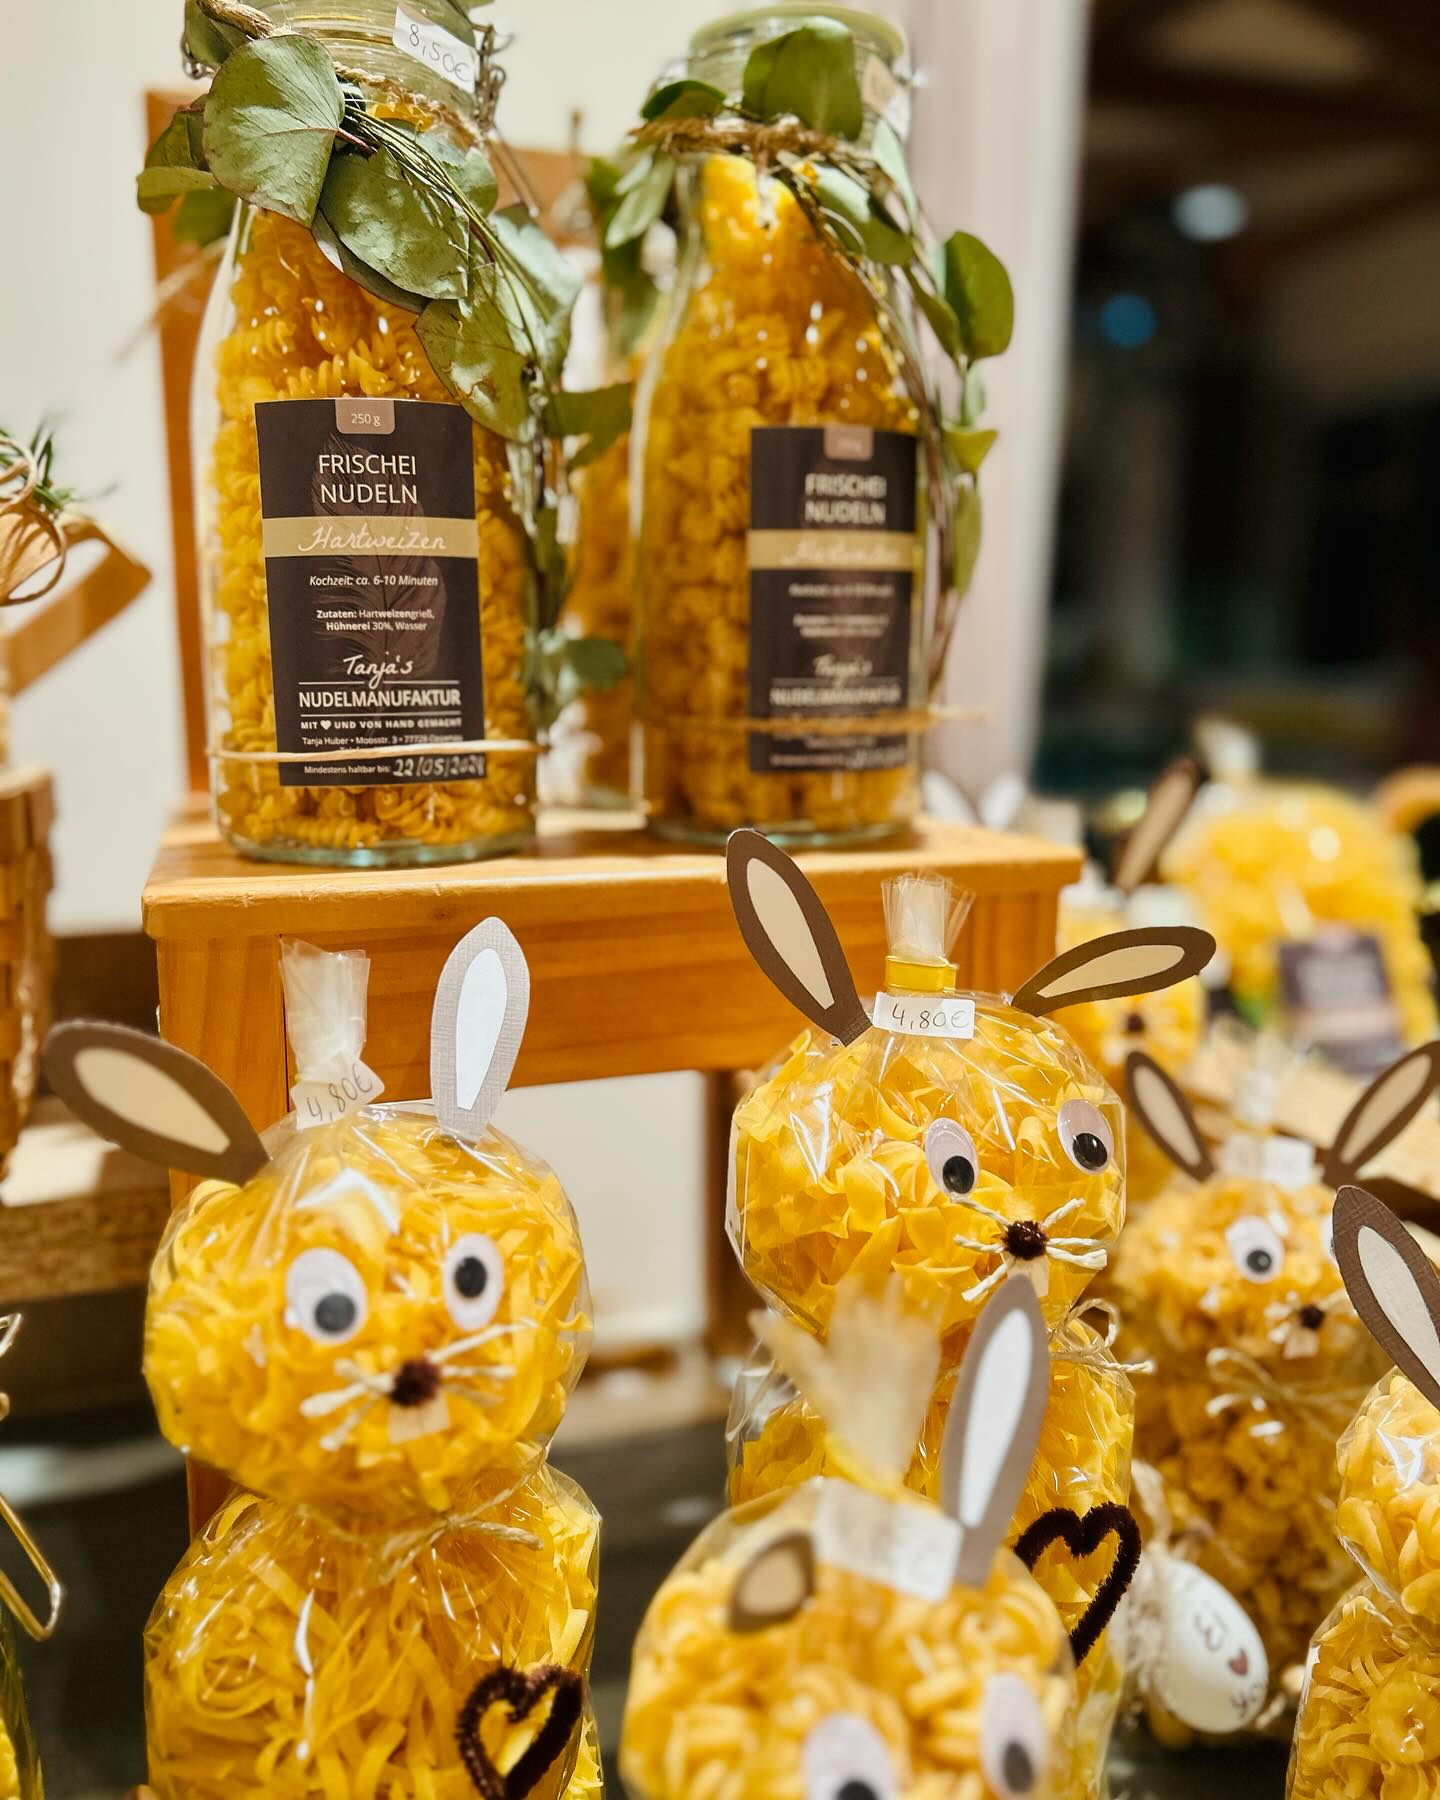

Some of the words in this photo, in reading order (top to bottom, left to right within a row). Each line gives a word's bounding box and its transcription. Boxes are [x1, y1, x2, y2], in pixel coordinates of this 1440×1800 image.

[408, 23, 472, 82] 8,50€
[351, 413, 371, 425] 250
[373, 415, 381, 426] g
[318, 454, 417, 476] FRISCHEI
[320, 483, 418, 505] NUDELN
[297, 522, 447, 552] Hartweizen
[309, 575, 353, 587] Kochzeit:
[355, 577, 371, 586] ca.
[373, 575, 397, 586] 6-10
[398, 575, 438, 587] Minuten
[316, 609, 357, 619] Zutaten:
[326, 621, 371, 631] Hühnerei
[372, 621, 394, 632] 30%,
[395, 622, 428, 631] Wasser
[343, 650, 414, 690] Tanja's
[299, 689, 461, 708] NUDELMANUFAKTUR
[301, 721, 318, 729] MIT
[334, 720, 356, 729] UND
[359, 720, 382, 729] VON
[385, 718, 415, 728] HAND
[417, 717, 462, 728] GEMACHT
[302, 737, 323, 747] Tanja
[324, 736, 348, 745] Huber
[304, 766, 347, 774] Mindestens
[348, 765, 376, 774] haltbar
[890, 1003, 969, 1030] 4,80€
[306, 1063, 372, 1121] 4,80€
